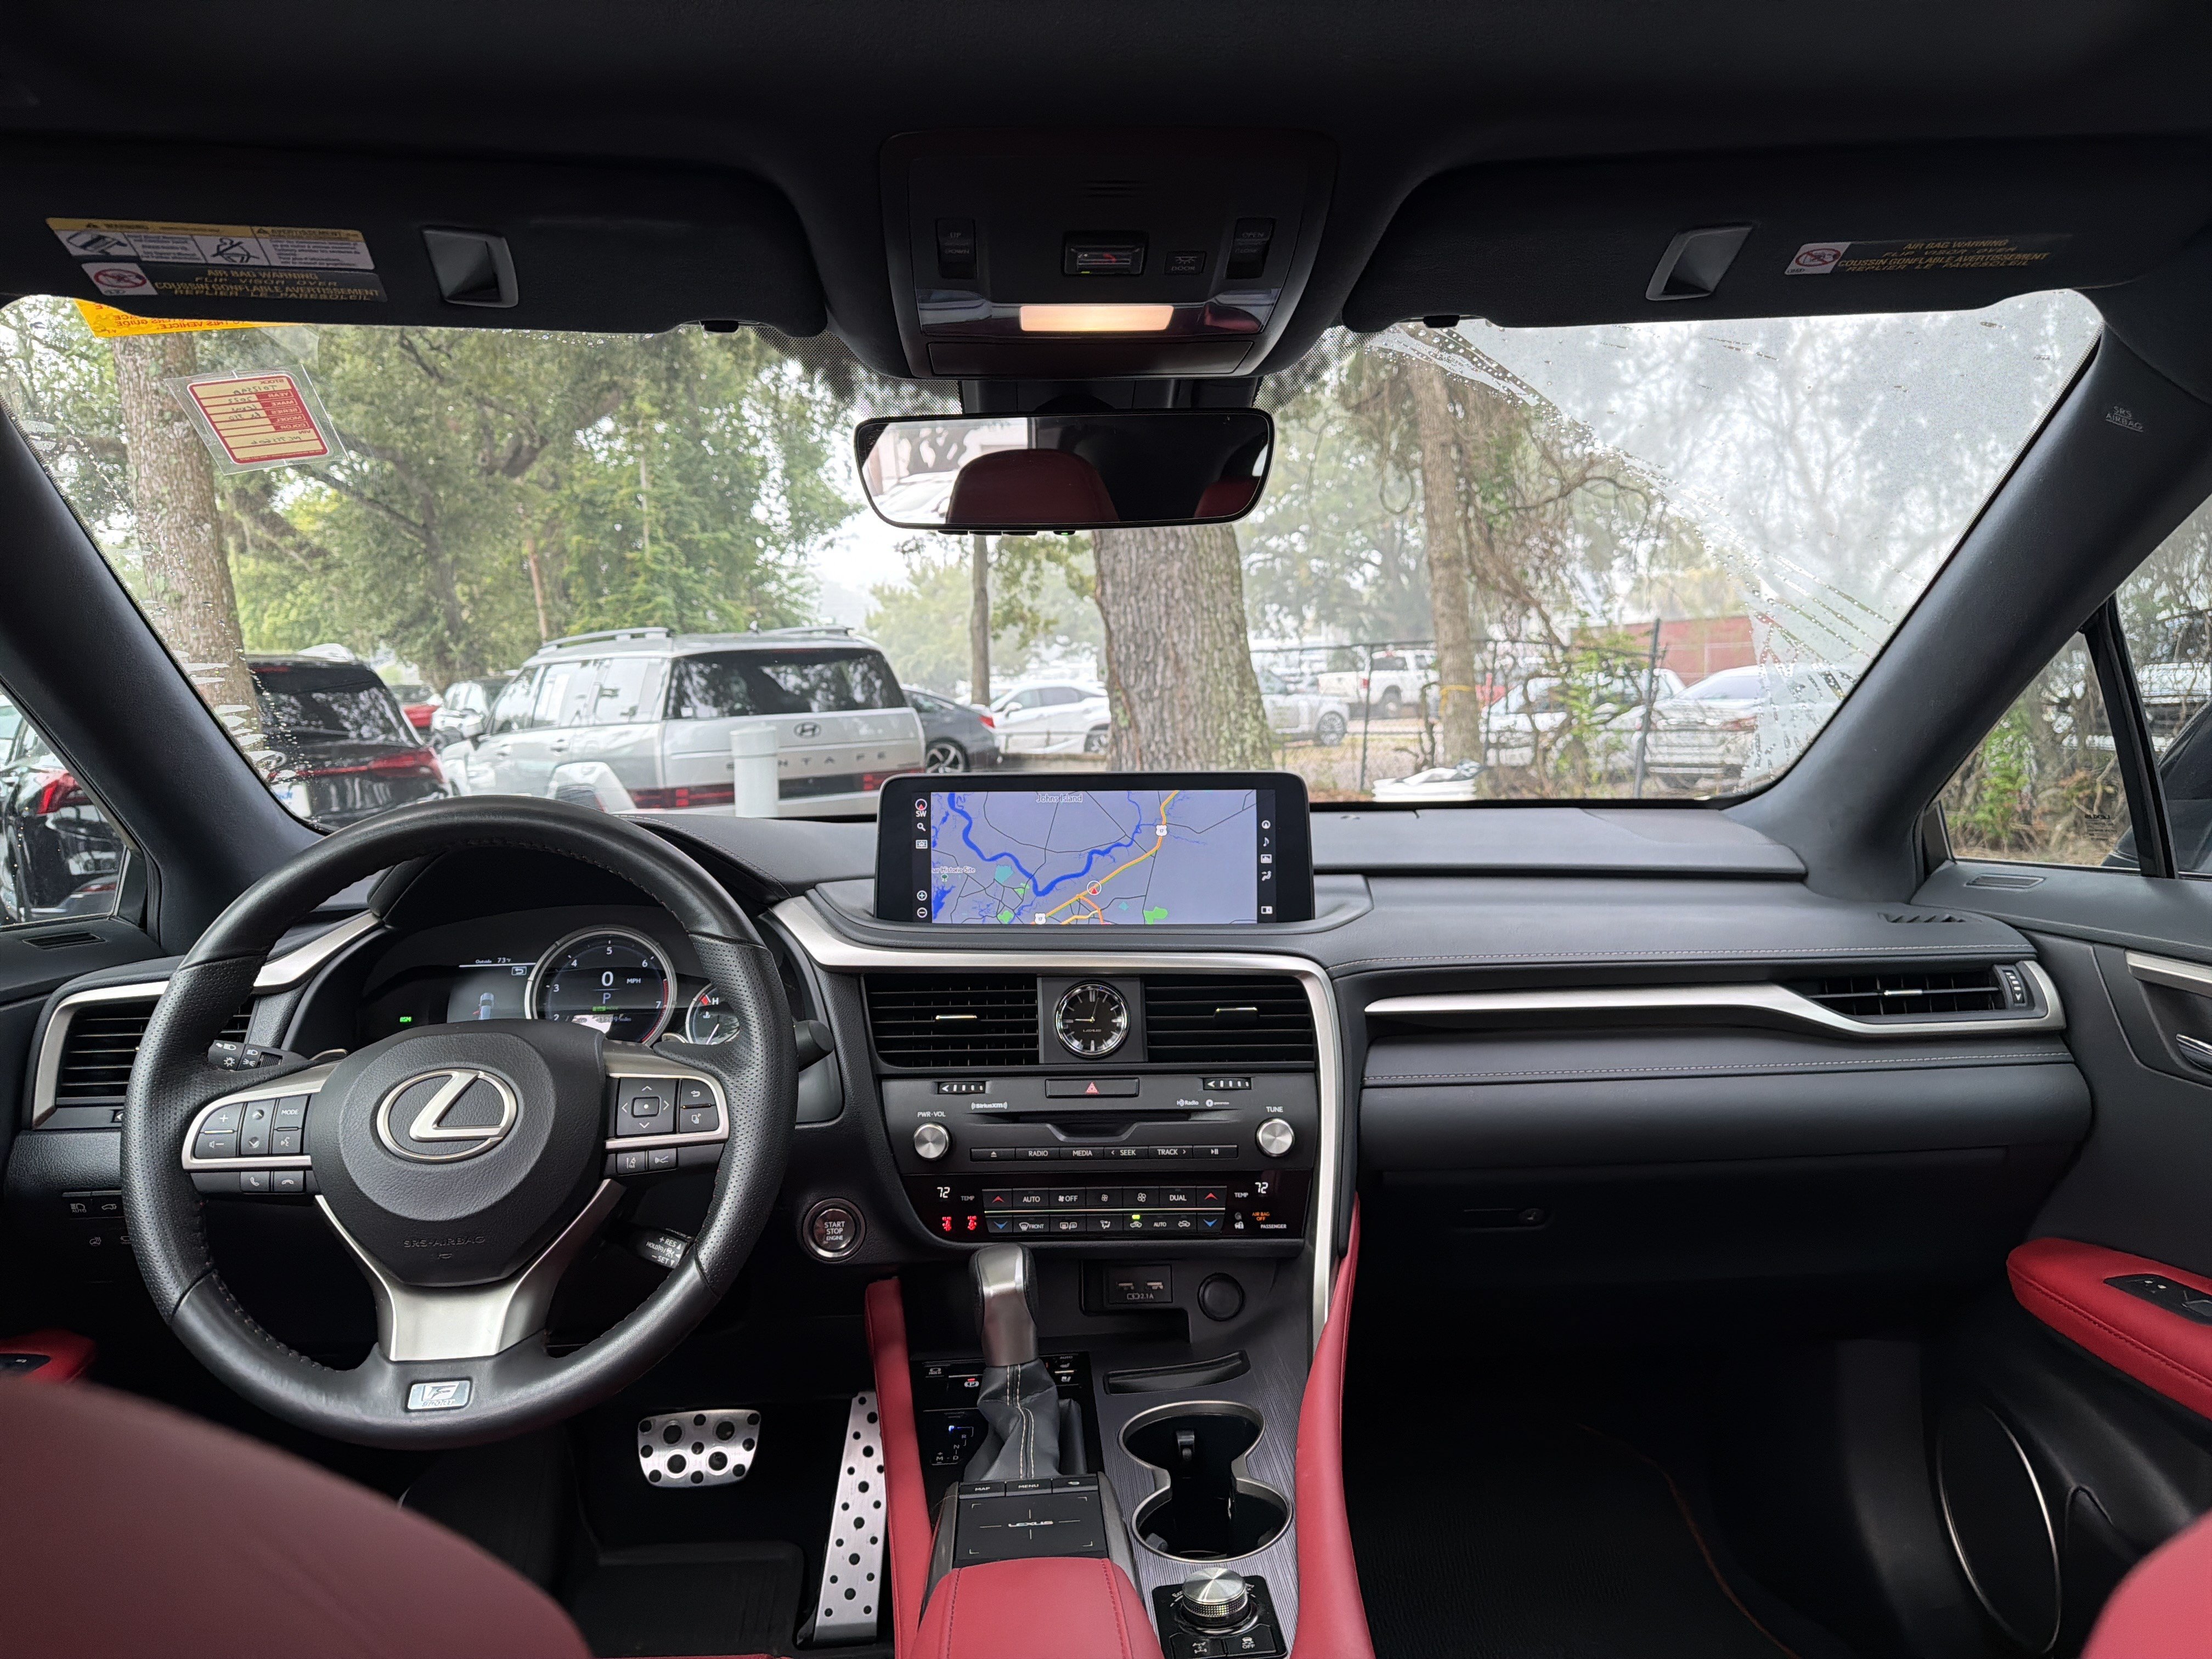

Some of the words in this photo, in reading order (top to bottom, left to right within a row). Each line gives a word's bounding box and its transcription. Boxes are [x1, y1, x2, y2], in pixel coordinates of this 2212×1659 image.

[1903, 242, 1925, 251] AIR
[1925, 241, 1951, 250] BAG
[1952, 239, 2009, 249] WARNING
[1888, 256, 1954, 266] GONFLABLE
[1954, 252, 2051, 263] AVERTISSEMENT
[207, 269, 228, 277] AIR
[230, 270, 256, 278] BAG
[262, 270, 319, 280] WARNING
[154, 281, 211, 290] COUSSIN
[211, 284, 283, 292] GONFLABLE
[285, 286, 379, 296] AVERTISSEMENT
[2113, 405, 2132, 418] SRS
[2106, 413, 2144, 431] AIRBAG
[1037, 794, 1059, 803] Johns
[1060, 794, 1082, 802] Island
[606, 946, 613, 955] 5
[571, 959, 578, 967] 4
[641, 959, 648, 968] 6
[601, 970, 614, 986] 0
[553, 984, 560, 992] 3
[602, 992, 612, 1004] P
[712, 997, 719, 1005] H
[656, 1001, 662, 1009] 7
[936, 1187, 950, 1198] 72
[1254, 1182, 1269, 1194] 72
[646, 1241, 658, 1251] HOLD
[421, 1398, 456, 1407] SPORT
